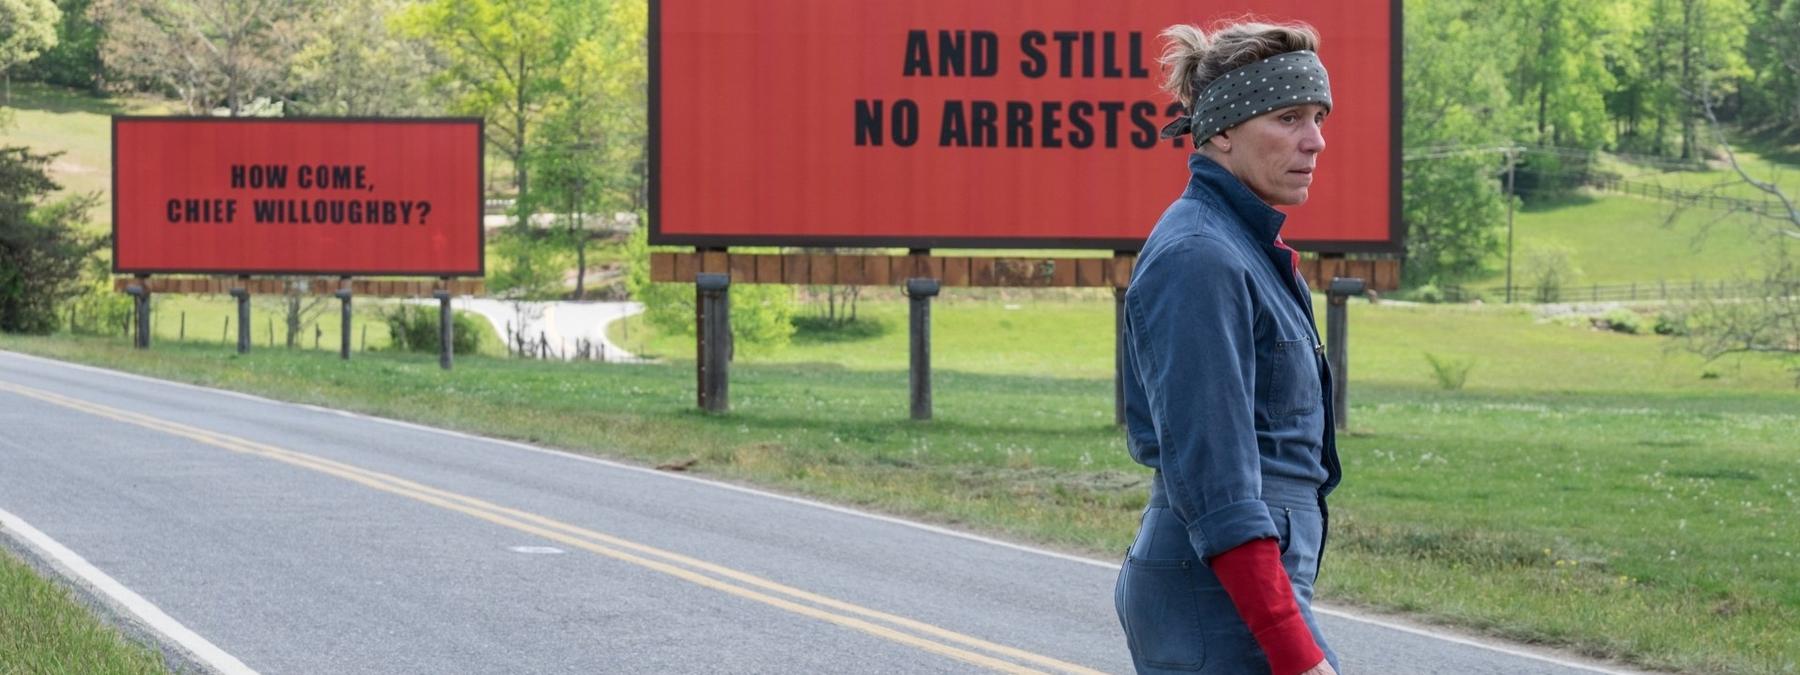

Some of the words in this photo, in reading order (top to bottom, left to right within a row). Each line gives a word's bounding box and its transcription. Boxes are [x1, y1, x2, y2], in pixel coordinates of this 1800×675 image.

[903, 30, 999, 78] AND
[1019, 30, 1150, 79] STILL
[853, 99, 919, 148] NO
[230, 164, 288, 190] HOW
[297, 164, 374, 192] COME,
[166, 199, 237, 224] CHIEF
[253, 199, 432, 226] WILLOUGHBY?
